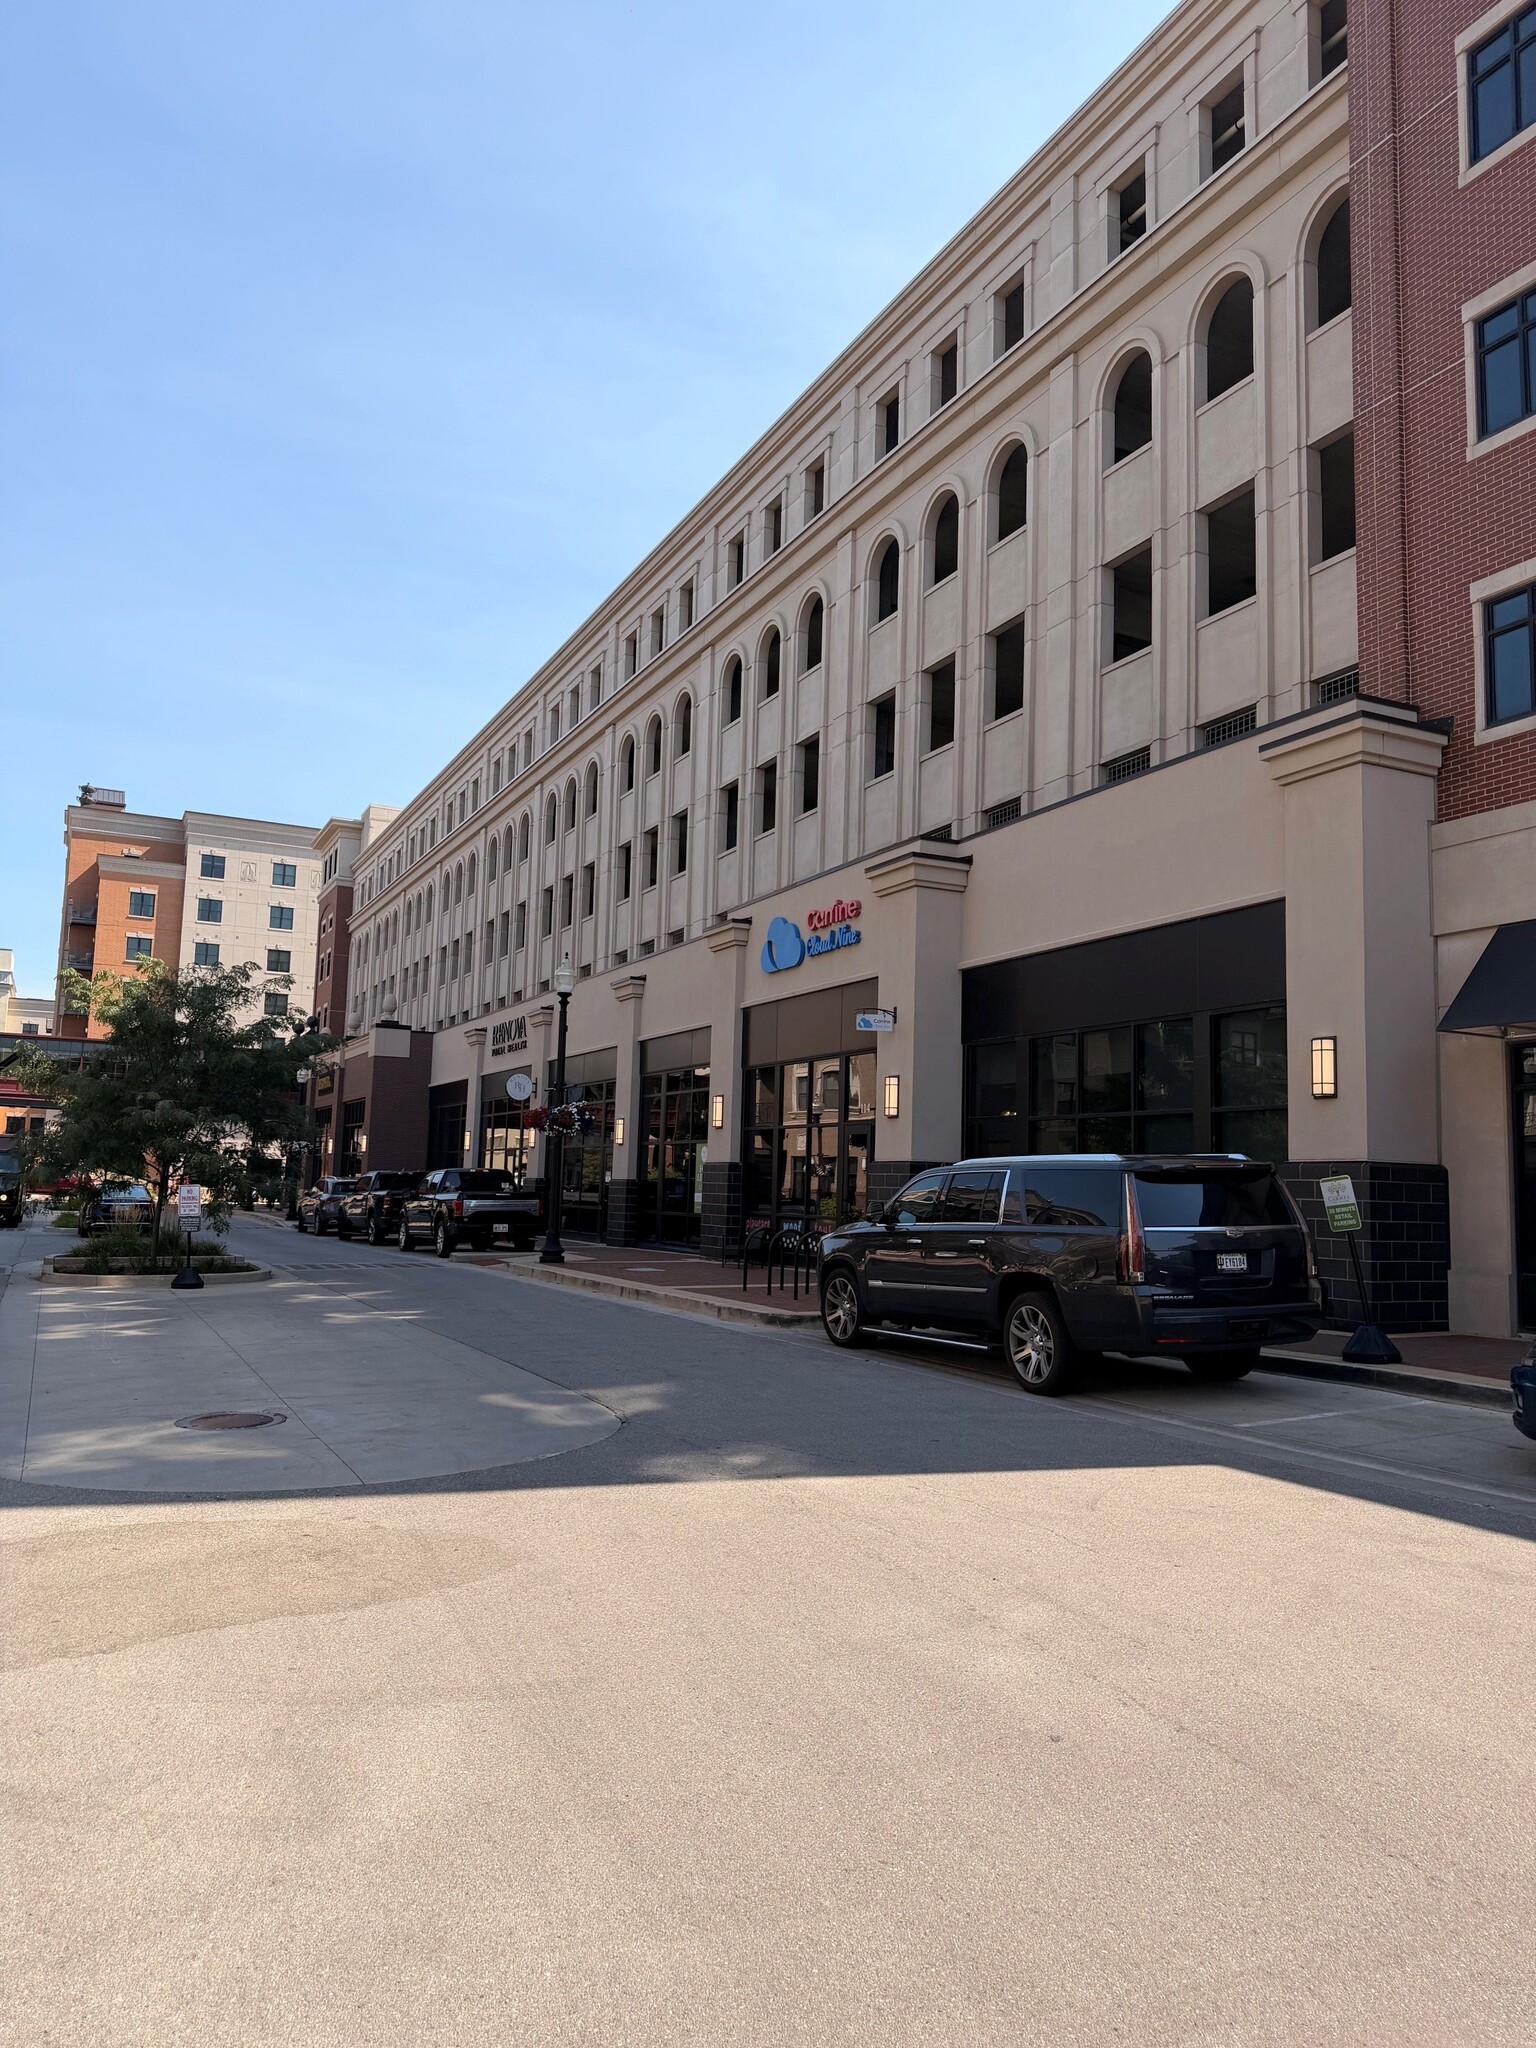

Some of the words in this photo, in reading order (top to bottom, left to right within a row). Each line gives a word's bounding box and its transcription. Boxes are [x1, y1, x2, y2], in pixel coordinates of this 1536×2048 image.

[806, 930, 836, 957] Cloud
[834, 924, 861, 949] Nine
[1335, 1205, 1355, 1213] MINUTE
[783, 1220, 802, 1232] woof
